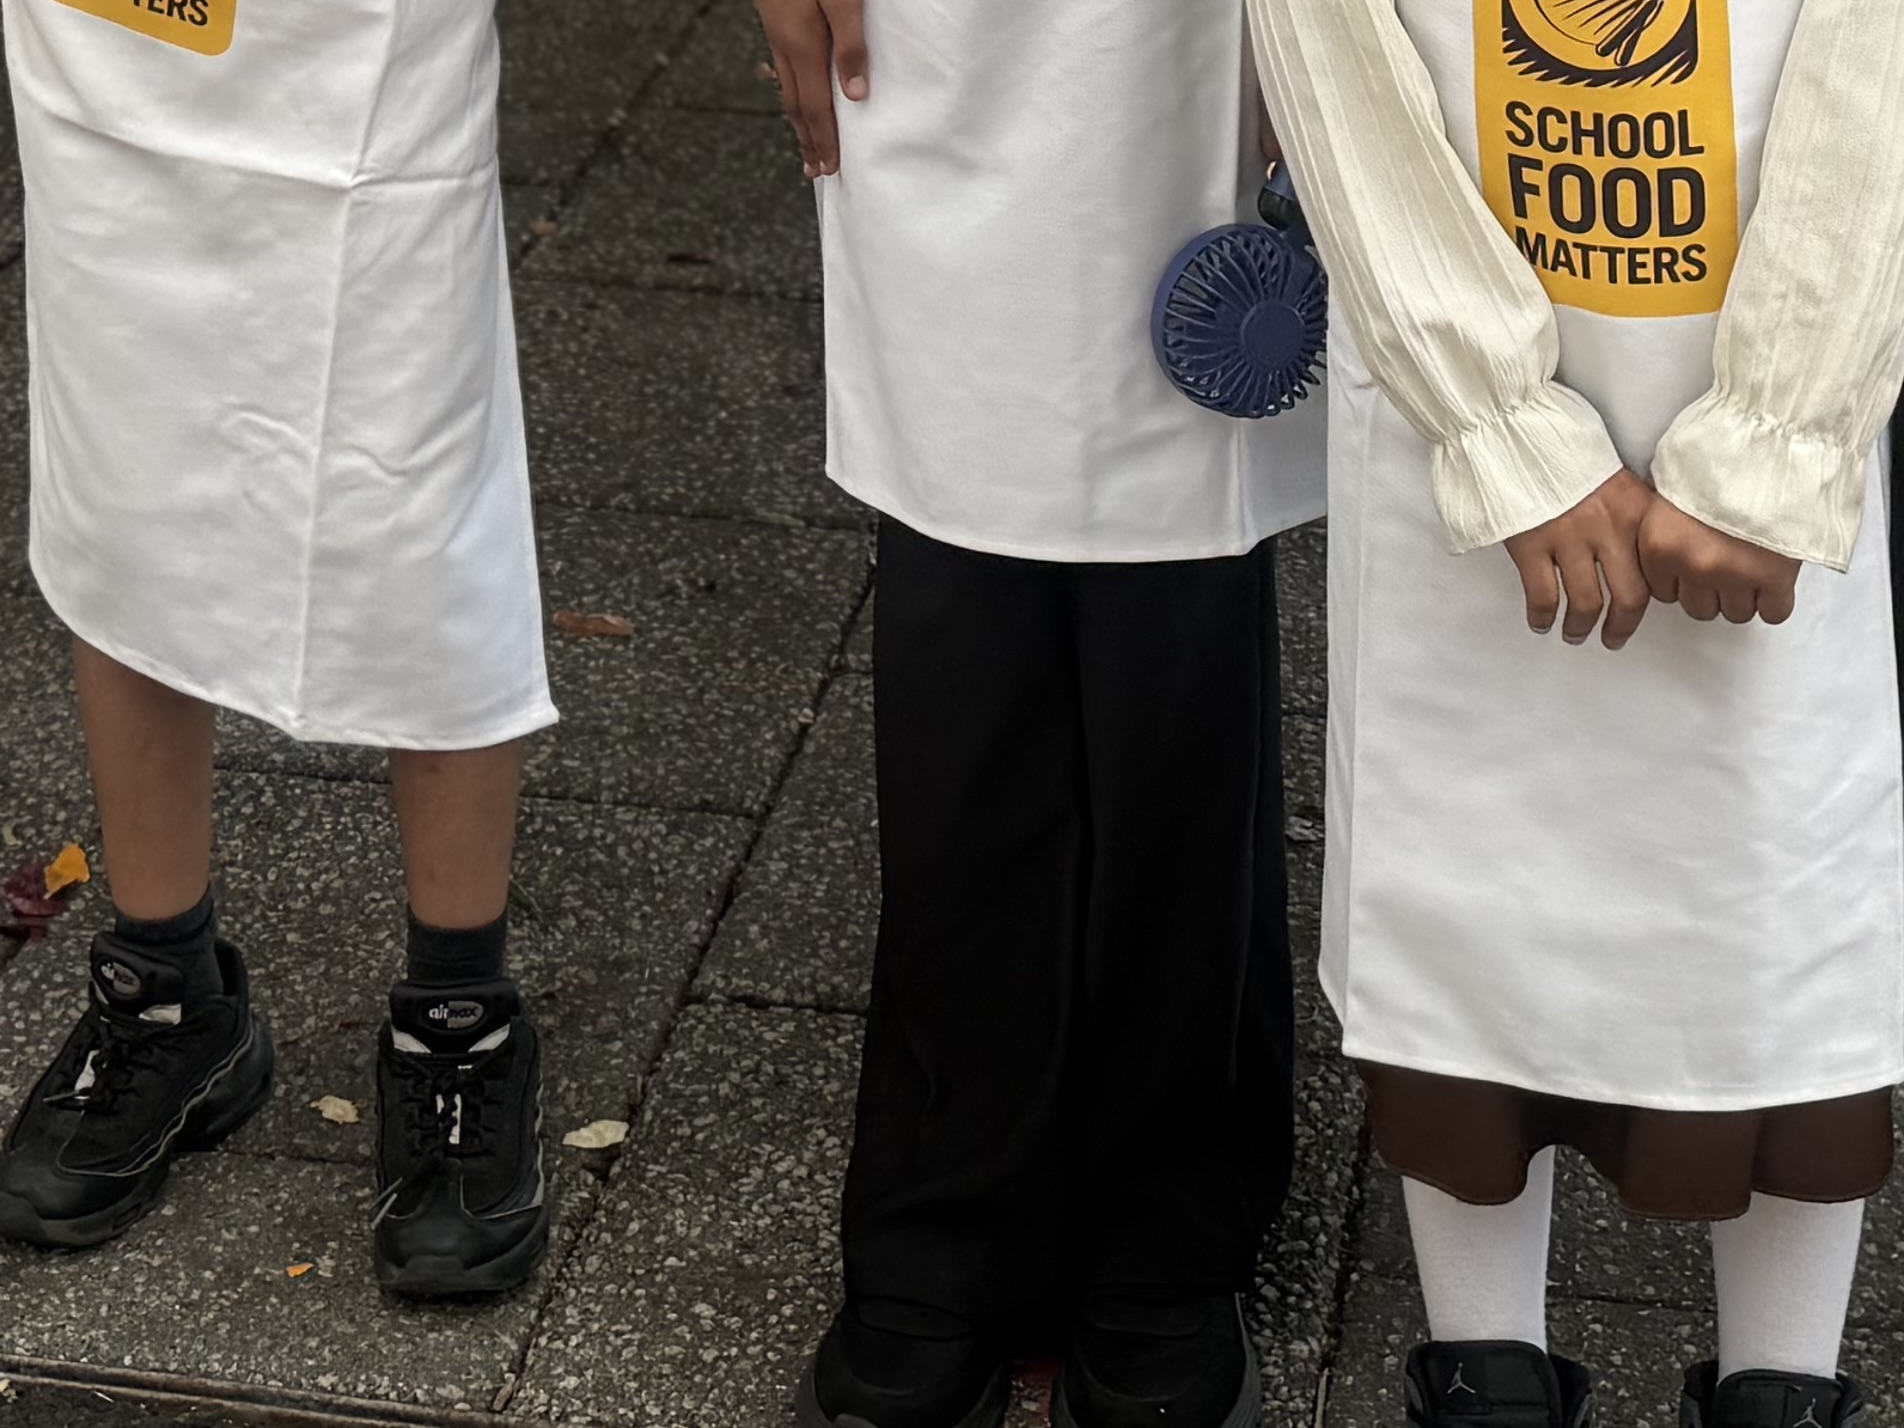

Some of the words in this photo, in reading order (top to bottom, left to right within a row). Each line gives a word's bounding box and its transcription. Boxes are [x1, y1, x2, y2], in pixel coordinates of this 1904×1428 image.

[1504, 100, 1706, 160] SCHOOL
[1506, 152, 1707, 240] FOOD
[1515, 225, 1709, 285] MATTERS
